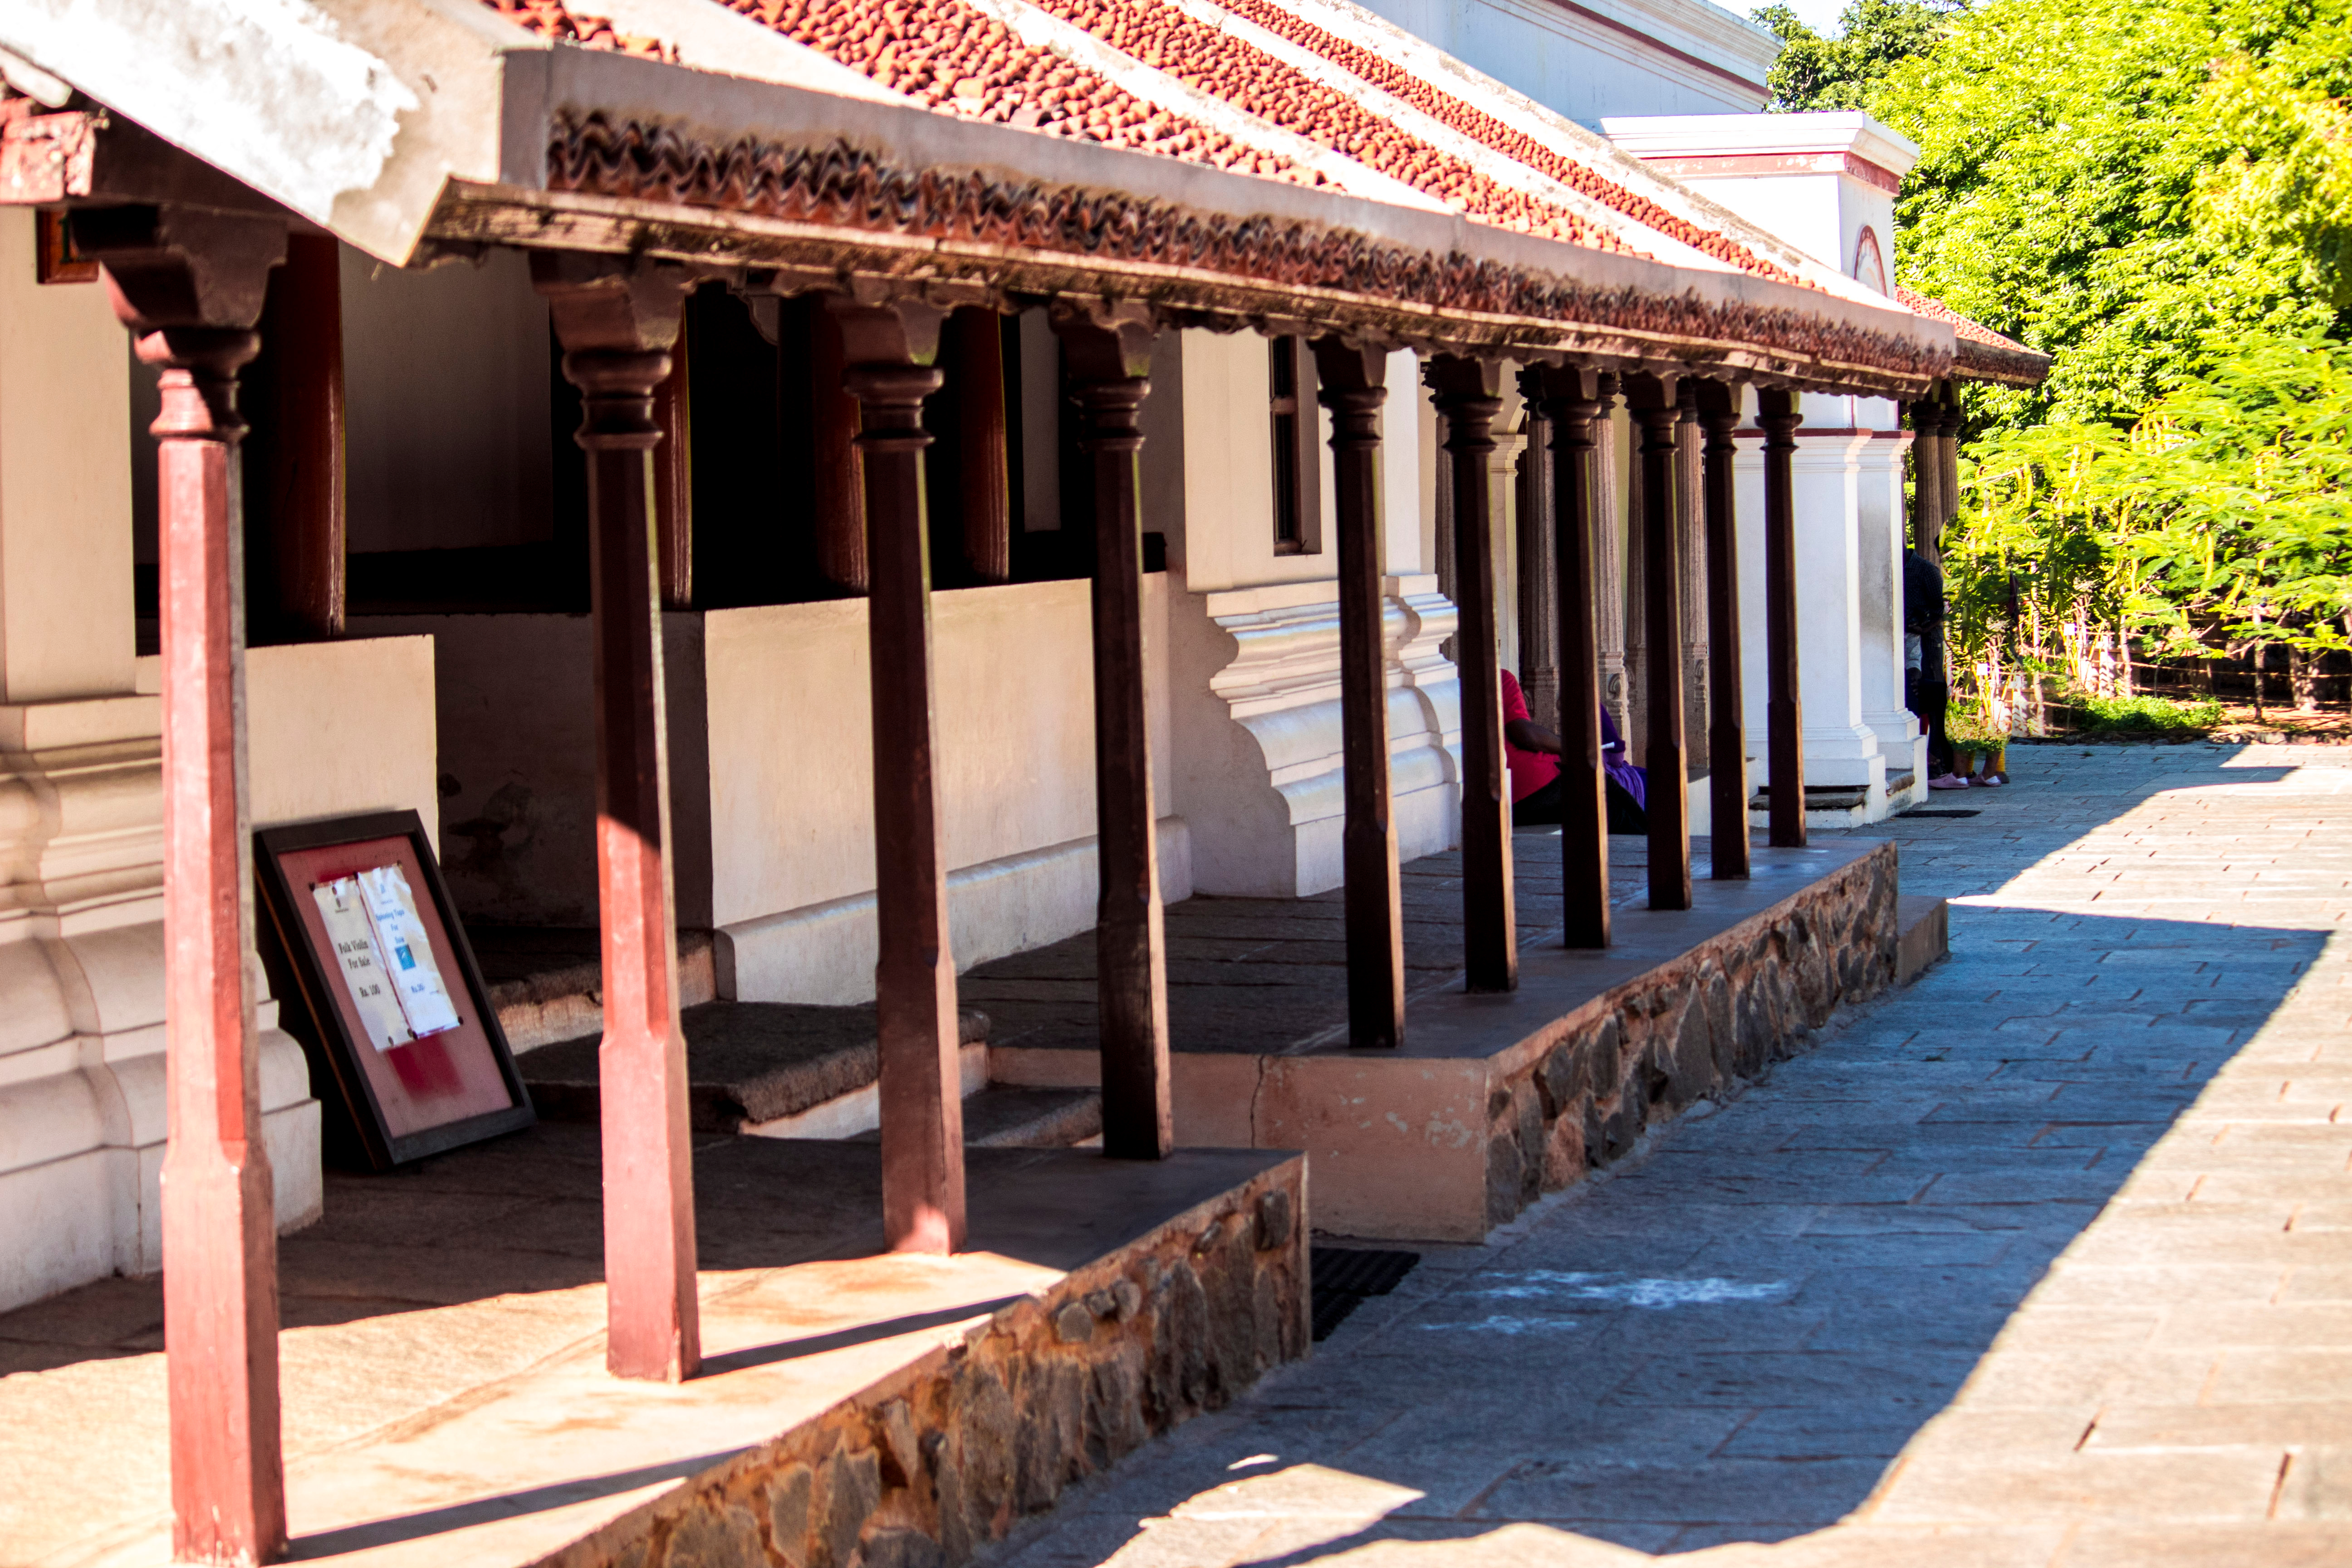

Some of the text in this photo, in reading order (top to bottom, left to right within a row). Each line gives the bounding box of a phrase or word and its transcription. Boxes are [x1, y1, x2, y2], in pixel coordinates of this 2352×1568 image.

[338, 939, 368, 954] Folk Violin
[348, 956, 370, 970] For Sale
